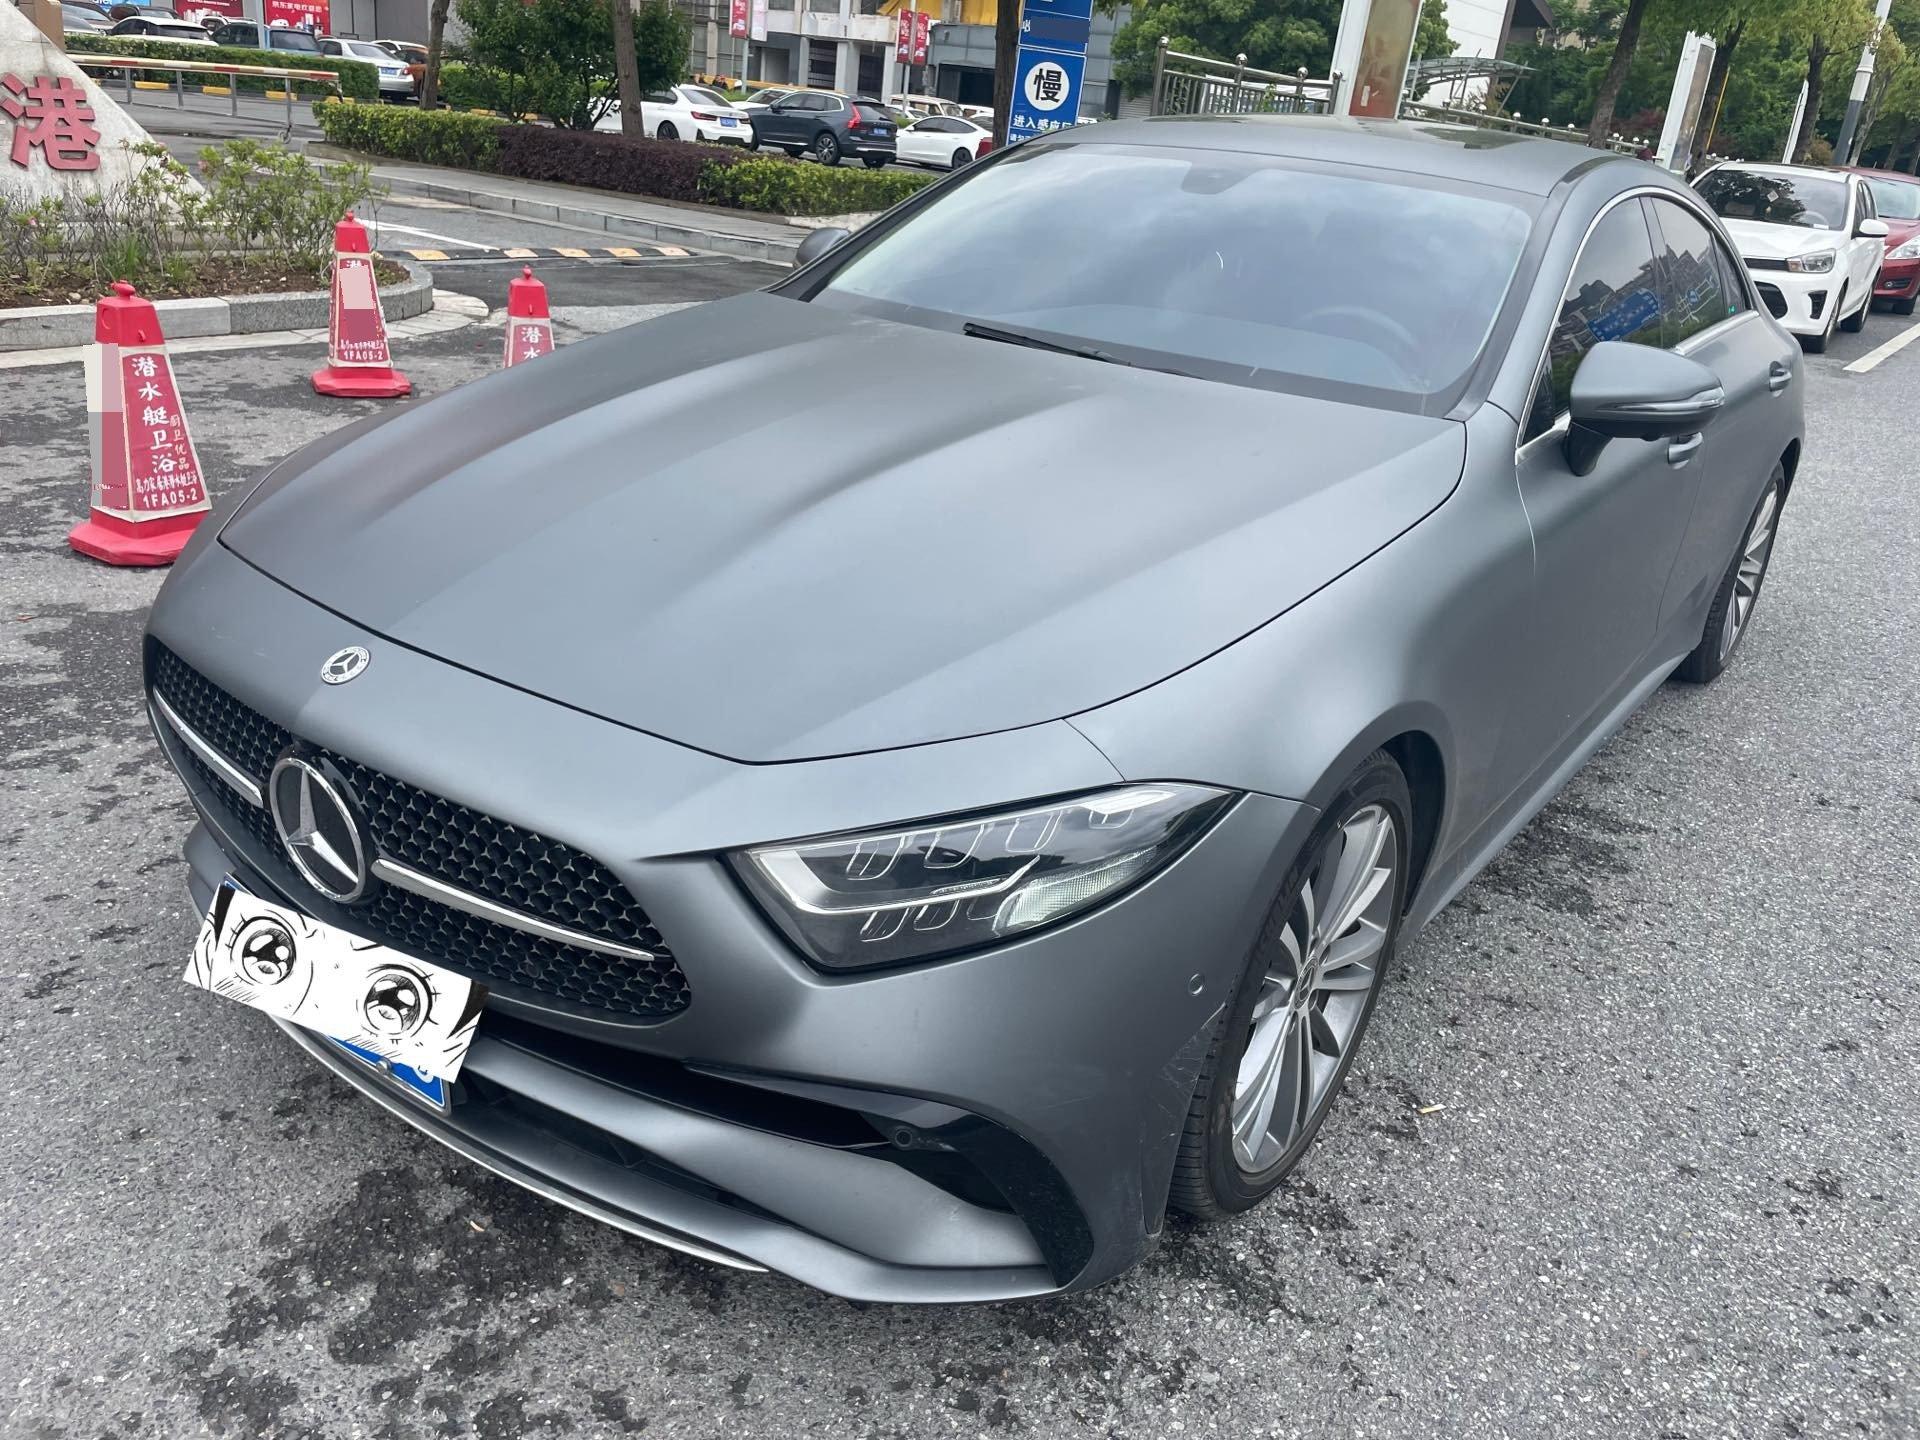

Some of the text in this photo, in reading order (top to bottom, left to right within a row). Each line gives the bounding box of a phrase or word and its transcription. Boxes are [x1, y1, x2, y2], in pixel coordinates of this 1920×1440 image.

[1033, 68, 1063, 103] 慢
[0, 72, 101, 171] 港
[343, 350, 383, 360] 1FA05-2
[131, 356, 178, 474] 潜水艇卫浴
[170, 414, 190, 470] 厨卫优品
[142, 488, 198, 509] 1FA05-2
